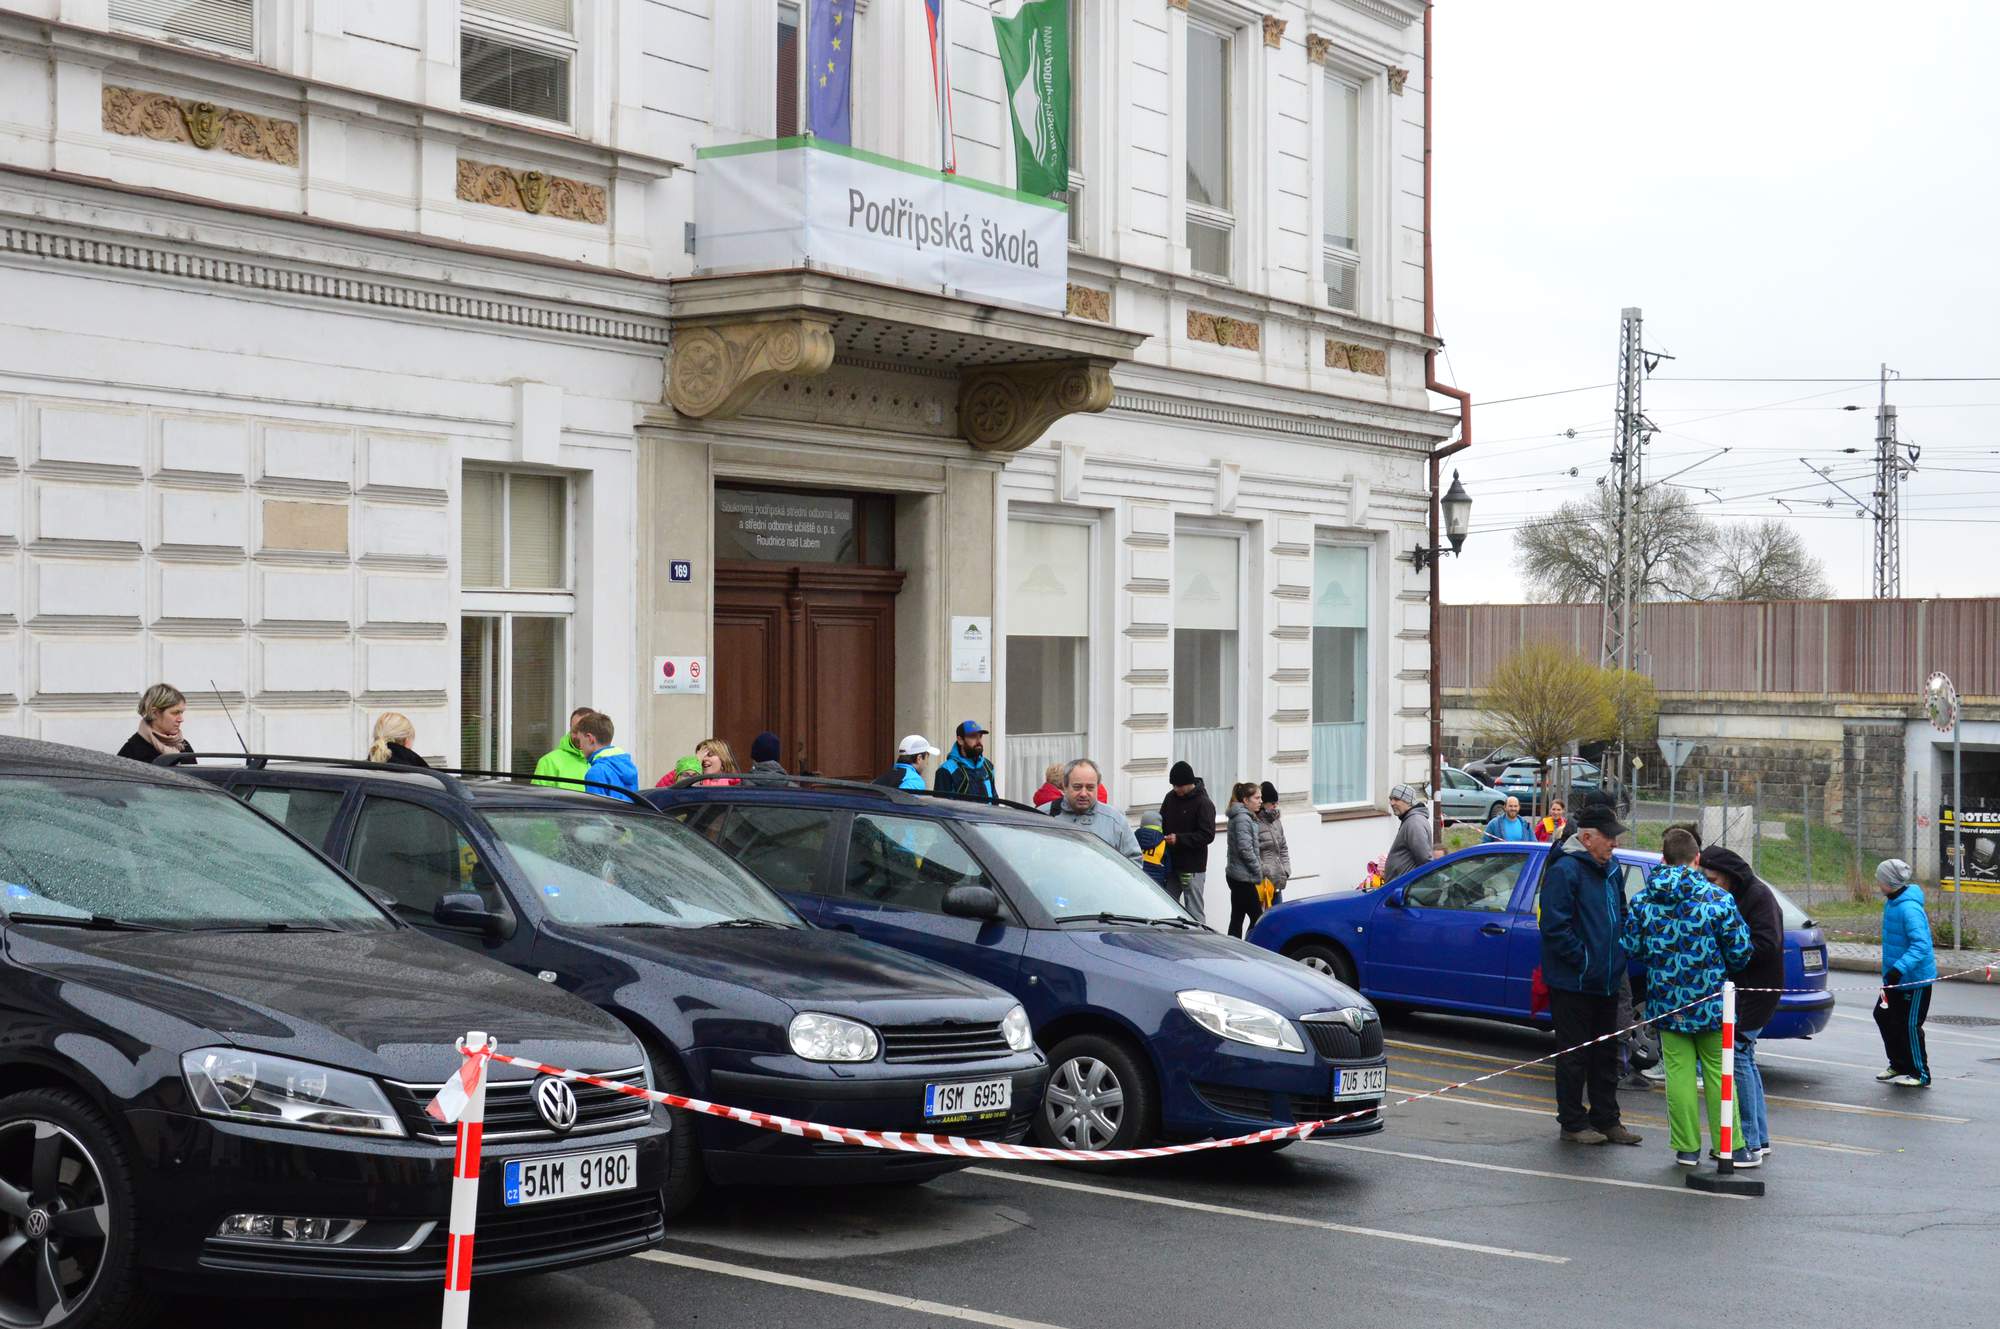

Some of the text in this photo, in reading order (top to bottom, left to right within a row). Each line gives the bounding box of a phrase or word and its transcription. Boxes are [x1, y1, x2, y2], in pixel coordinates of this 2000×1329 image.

[849, 188, 1039, 268] Podřipská škola
[745, 519, 766, 530] střední
[768, 520, 793, 532] odborné
[756, 535, 820, 548] Roudnice nad Labem
[674, 564, 688, 578] 169
[1342, 1072, 1358, 1092] 7U5
[1363, 1070, 1382, 1089] 3123
[939, 1083, 1005, 1111] 1SM 6953
[525, 1154, 628, 1197] 5AM 9180
[507, 1189, 518, 1199] CZ
